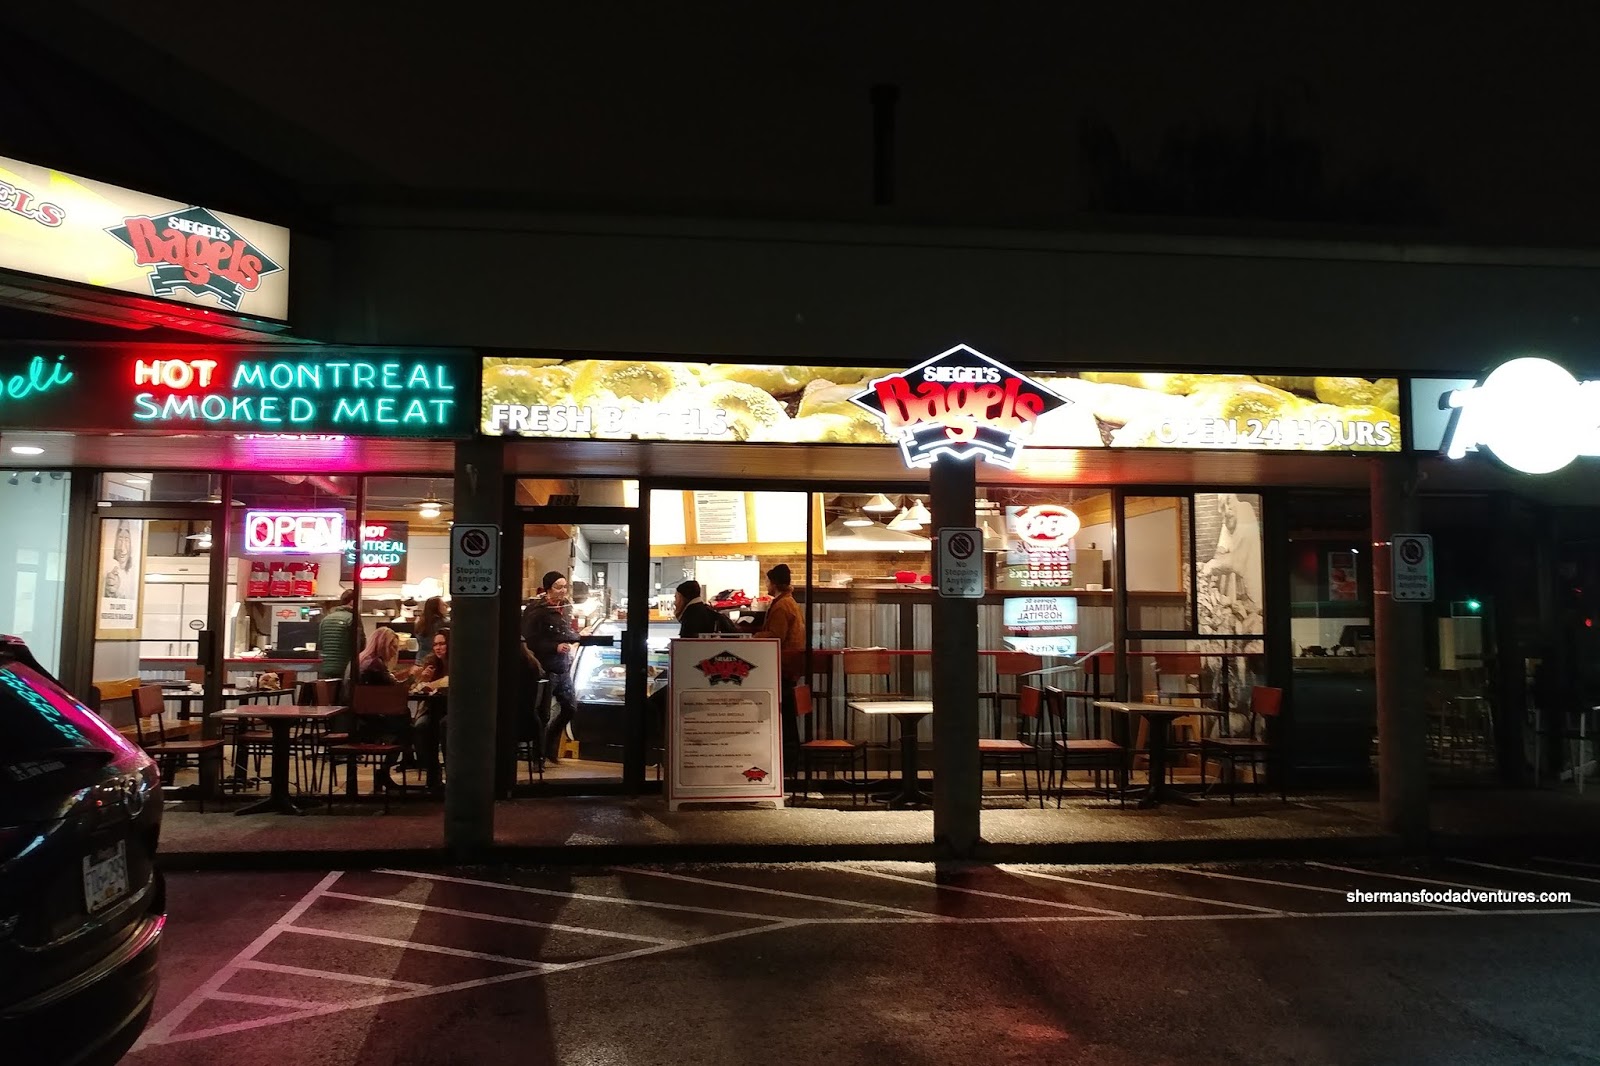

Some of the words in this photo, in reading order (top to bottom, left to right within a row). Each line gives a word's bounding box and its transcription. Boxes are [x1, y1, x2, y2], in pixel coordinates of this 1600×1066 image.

[167, 215, 231, 242] SIEGEL'S
[123, 215, 263, 290] Bagels
[0, 354, 73, 398] eli
[134, 359, 218, 389] HOT
[232, 360, 455, 390] MONTREAL
[923, 366, 1001, 383] SIEGEL'S
[133, 393, 314, 422] SMOKED
[333, 398, 454, 424] MEAT
[491, 404, 592, 433] FRESH
[874, 376, 1045, 444] Bagels
[1154, 416, 1238, 446] OPEN
[1246, 418, 1284, 446] 24
[1295, 418, 1392, 447] HOURS
[250, 515, 338, 548] OPEN
[347, 553, 401, 565] SOKED
[456, 567, 493, 576] Stopping
[944, 569, 979, 577] Stopping
[457, 576, 491, 584] Anytime
